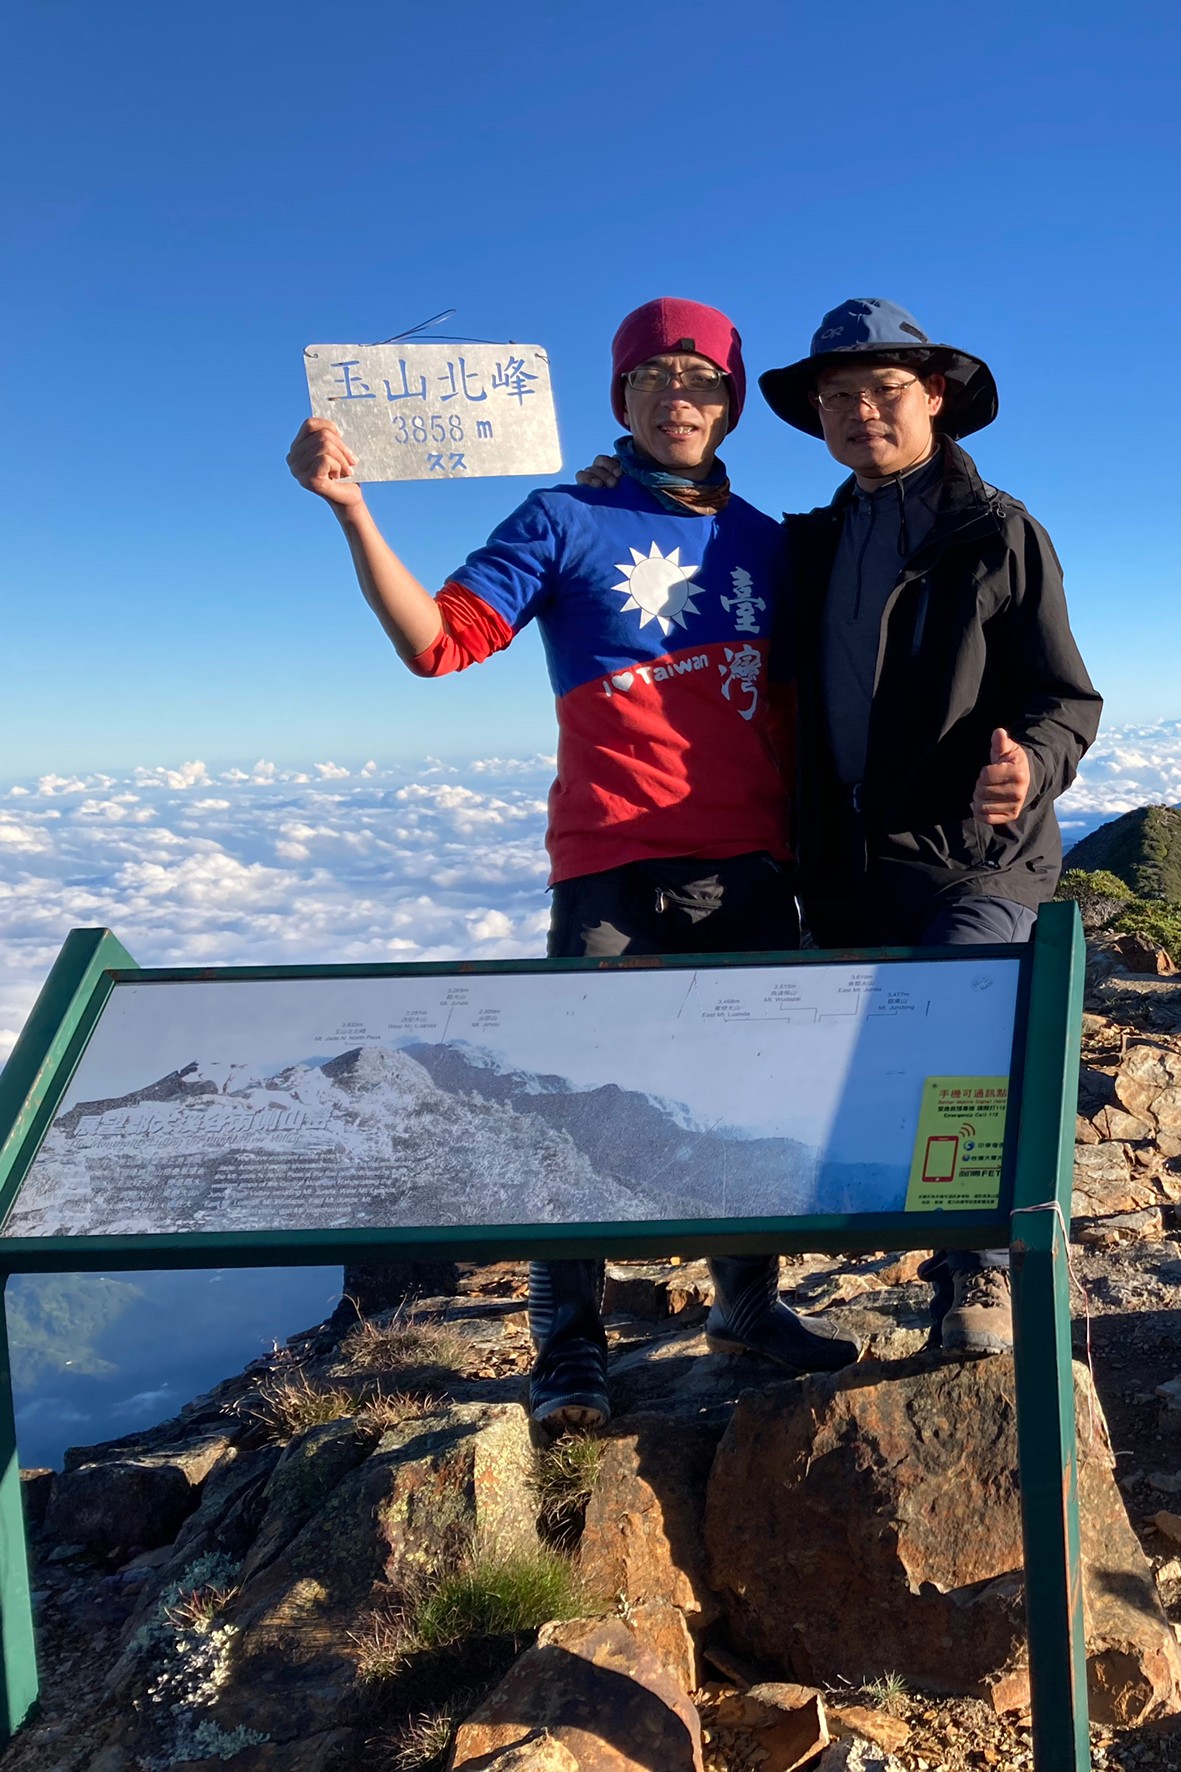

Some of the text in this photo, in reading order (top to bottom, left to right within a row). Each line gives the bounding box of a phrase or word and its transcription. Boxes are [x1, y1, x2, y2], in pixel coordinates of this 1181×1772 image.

[327, 355, 539, 406] 玉山北峰
[393, 415, 493, 444] 3858 m
[718, 566, 767, 721] 臺灣
[602, 654, 709, 697] I Taiwan
